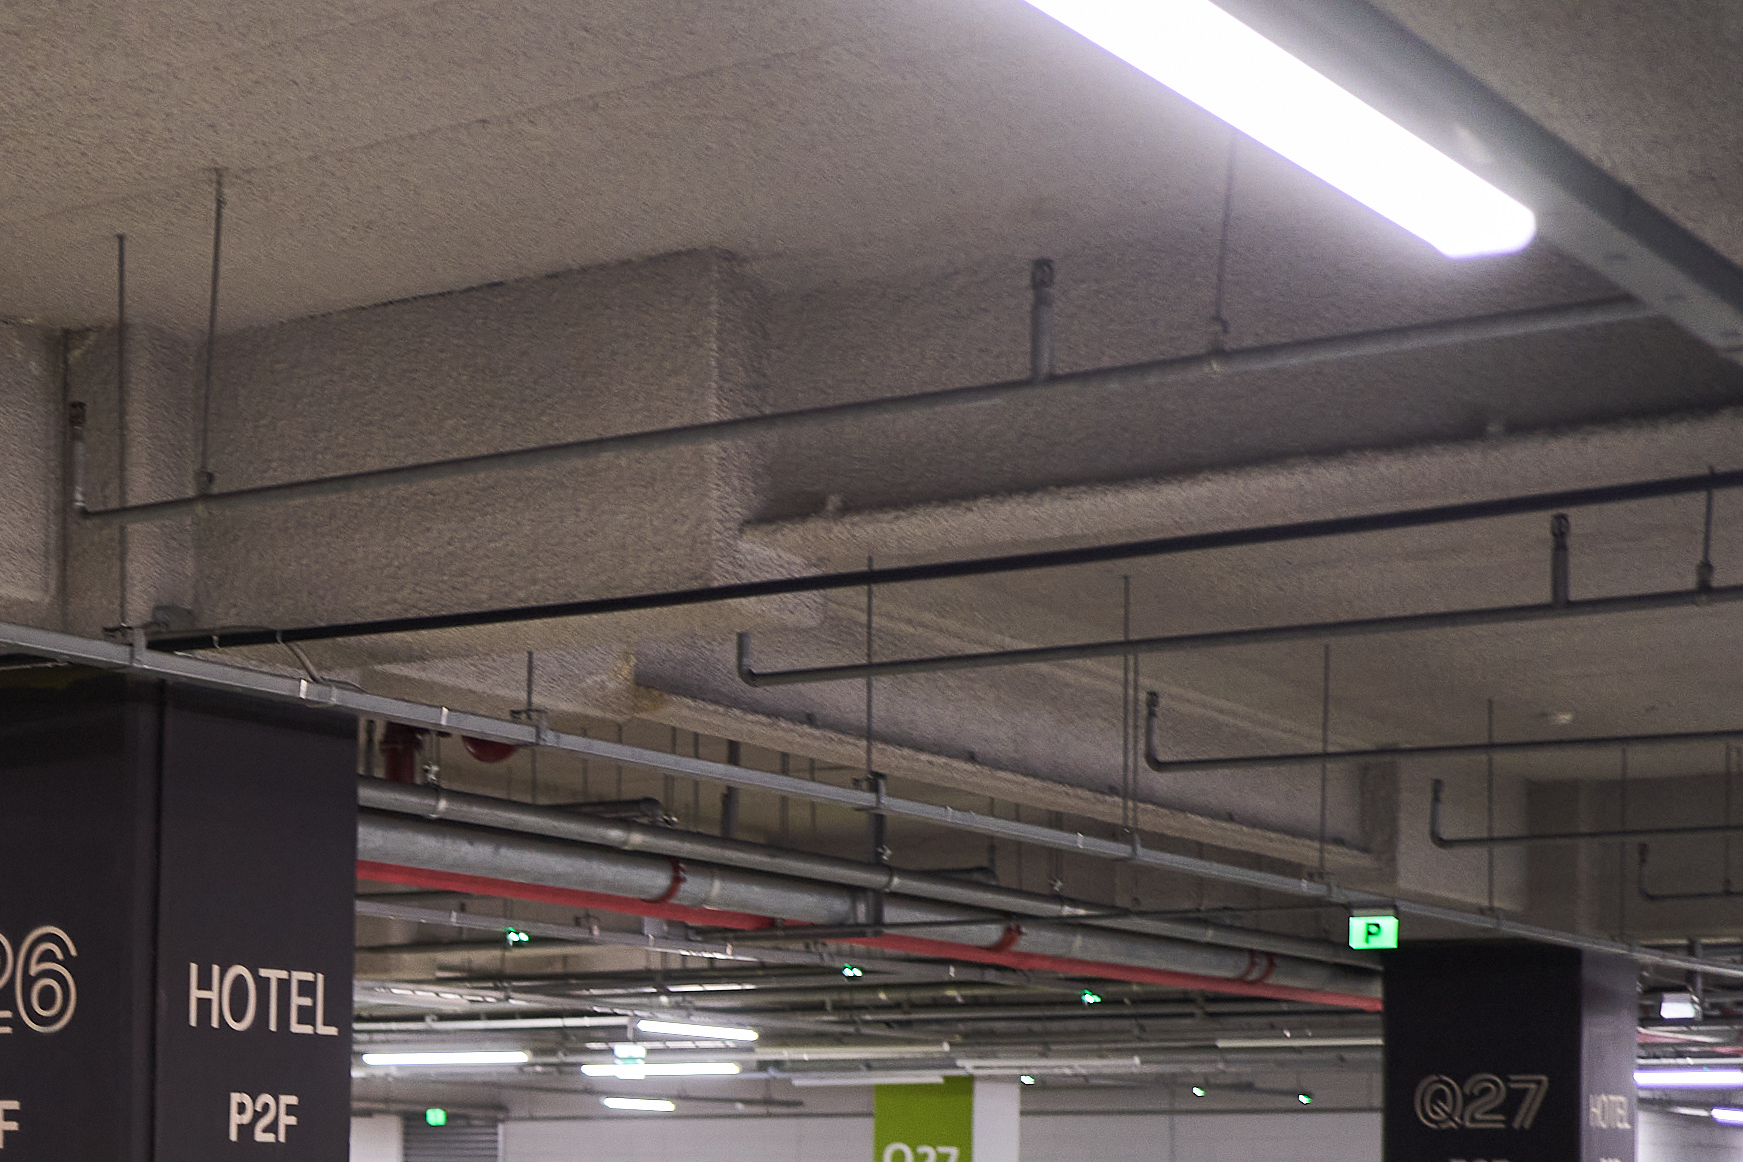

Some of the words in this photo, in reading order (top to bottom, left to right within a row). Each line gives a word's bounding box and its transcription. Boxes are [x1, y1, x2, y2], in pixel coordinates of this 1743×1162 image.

[1364, 922, 1382, 944] P
[188, 961, 339, 1036] HOTEL
[228, 1091, 299, 1144] P2F
[1413, 1073, 1549, 1130] Q27
